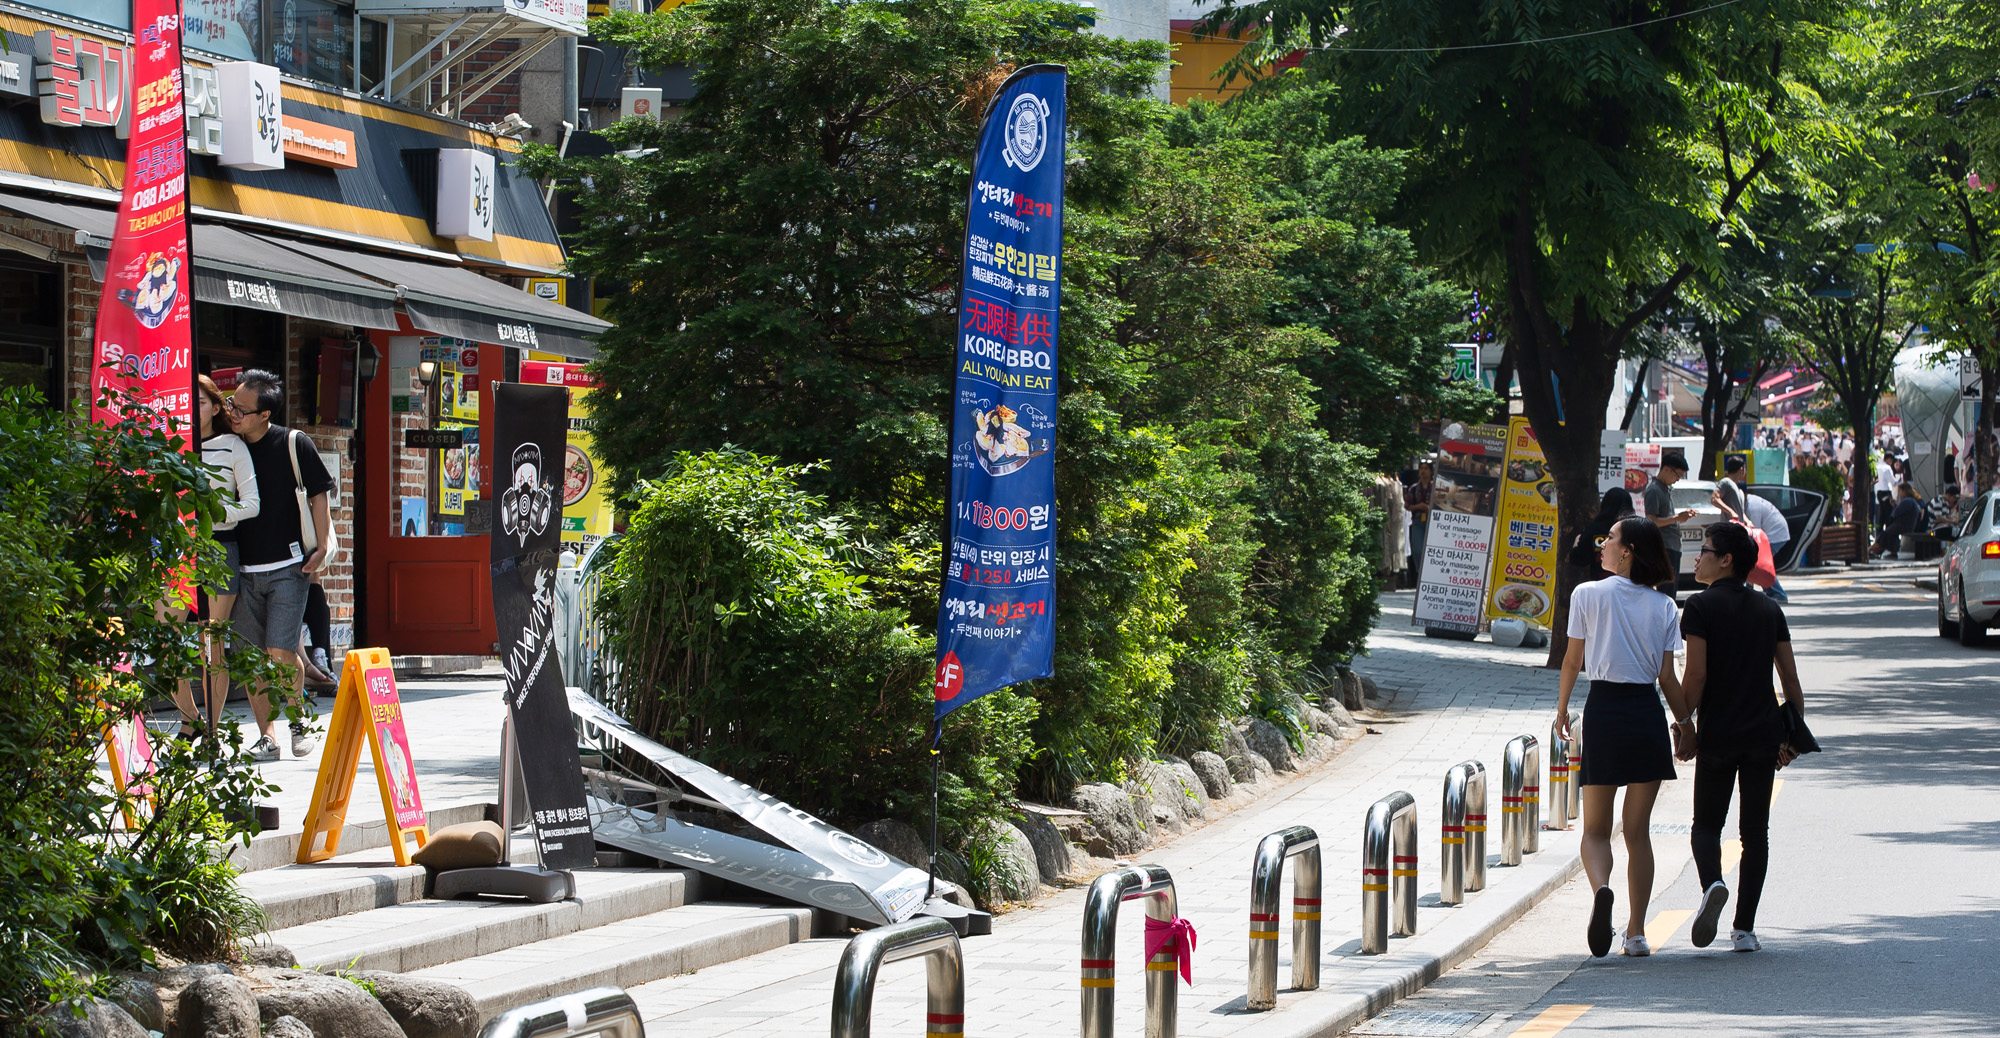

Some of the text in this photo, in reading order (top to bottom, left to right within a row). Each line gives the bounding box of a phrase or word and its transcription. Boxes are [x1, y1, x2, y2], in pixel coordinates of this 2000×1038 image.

[0, 60, 20, 80] TORE
[994, 242, 1056, 281] 무한리필
[227, 279, 249, 300] 불고기
[964, 298, 1052, 347] 无限提供
[964, 334, 1051, 370] KOREA BBQ
[962, 360, 1052, 389] ALL YOU AN EAT
[413, 434, 456, 443] CLOSED
[1433, 511, 1470, 525] 발 마사지
[1437, 523, 1482, 534] Foot massage
[1510, 520, 1555, 538] 베트남
[1452, 533, 1479, 541] マッサージ
[1508, 534, 1553, 552] 쌀국수
[1454, 540, 1487, 552] 18,000원
[981, 550, 1006, 566] 단위
[1011, 550, 1036, 566] 입장
[1039, 546, 1049, 561] 시
[1427, 548, 1473, 562] 전신 마사지
[1430, 559, 1480, 571] Body massage
[1453, 568, 1480, 577] マッサージ
[1015, 565, 1050, 583] 서비스
[1449, 576, 1482, 587] 18,000원
[1421, 584, 1479, 600] 아로마 마사지
[1423, 595, 1476, 608] Aroma massage
[1447, 604, 1477, 614] マッサージ
[1442, 612, 1477, 624] 25,000원
[957, 624, 1014, 639] 두번째 이야기
[371, 676, 391, 698] 아직도
[516, 685, 530, 710] DANCE
[545, 810, 557, 824] 공연
[556, 808, 568, 823] 행사
